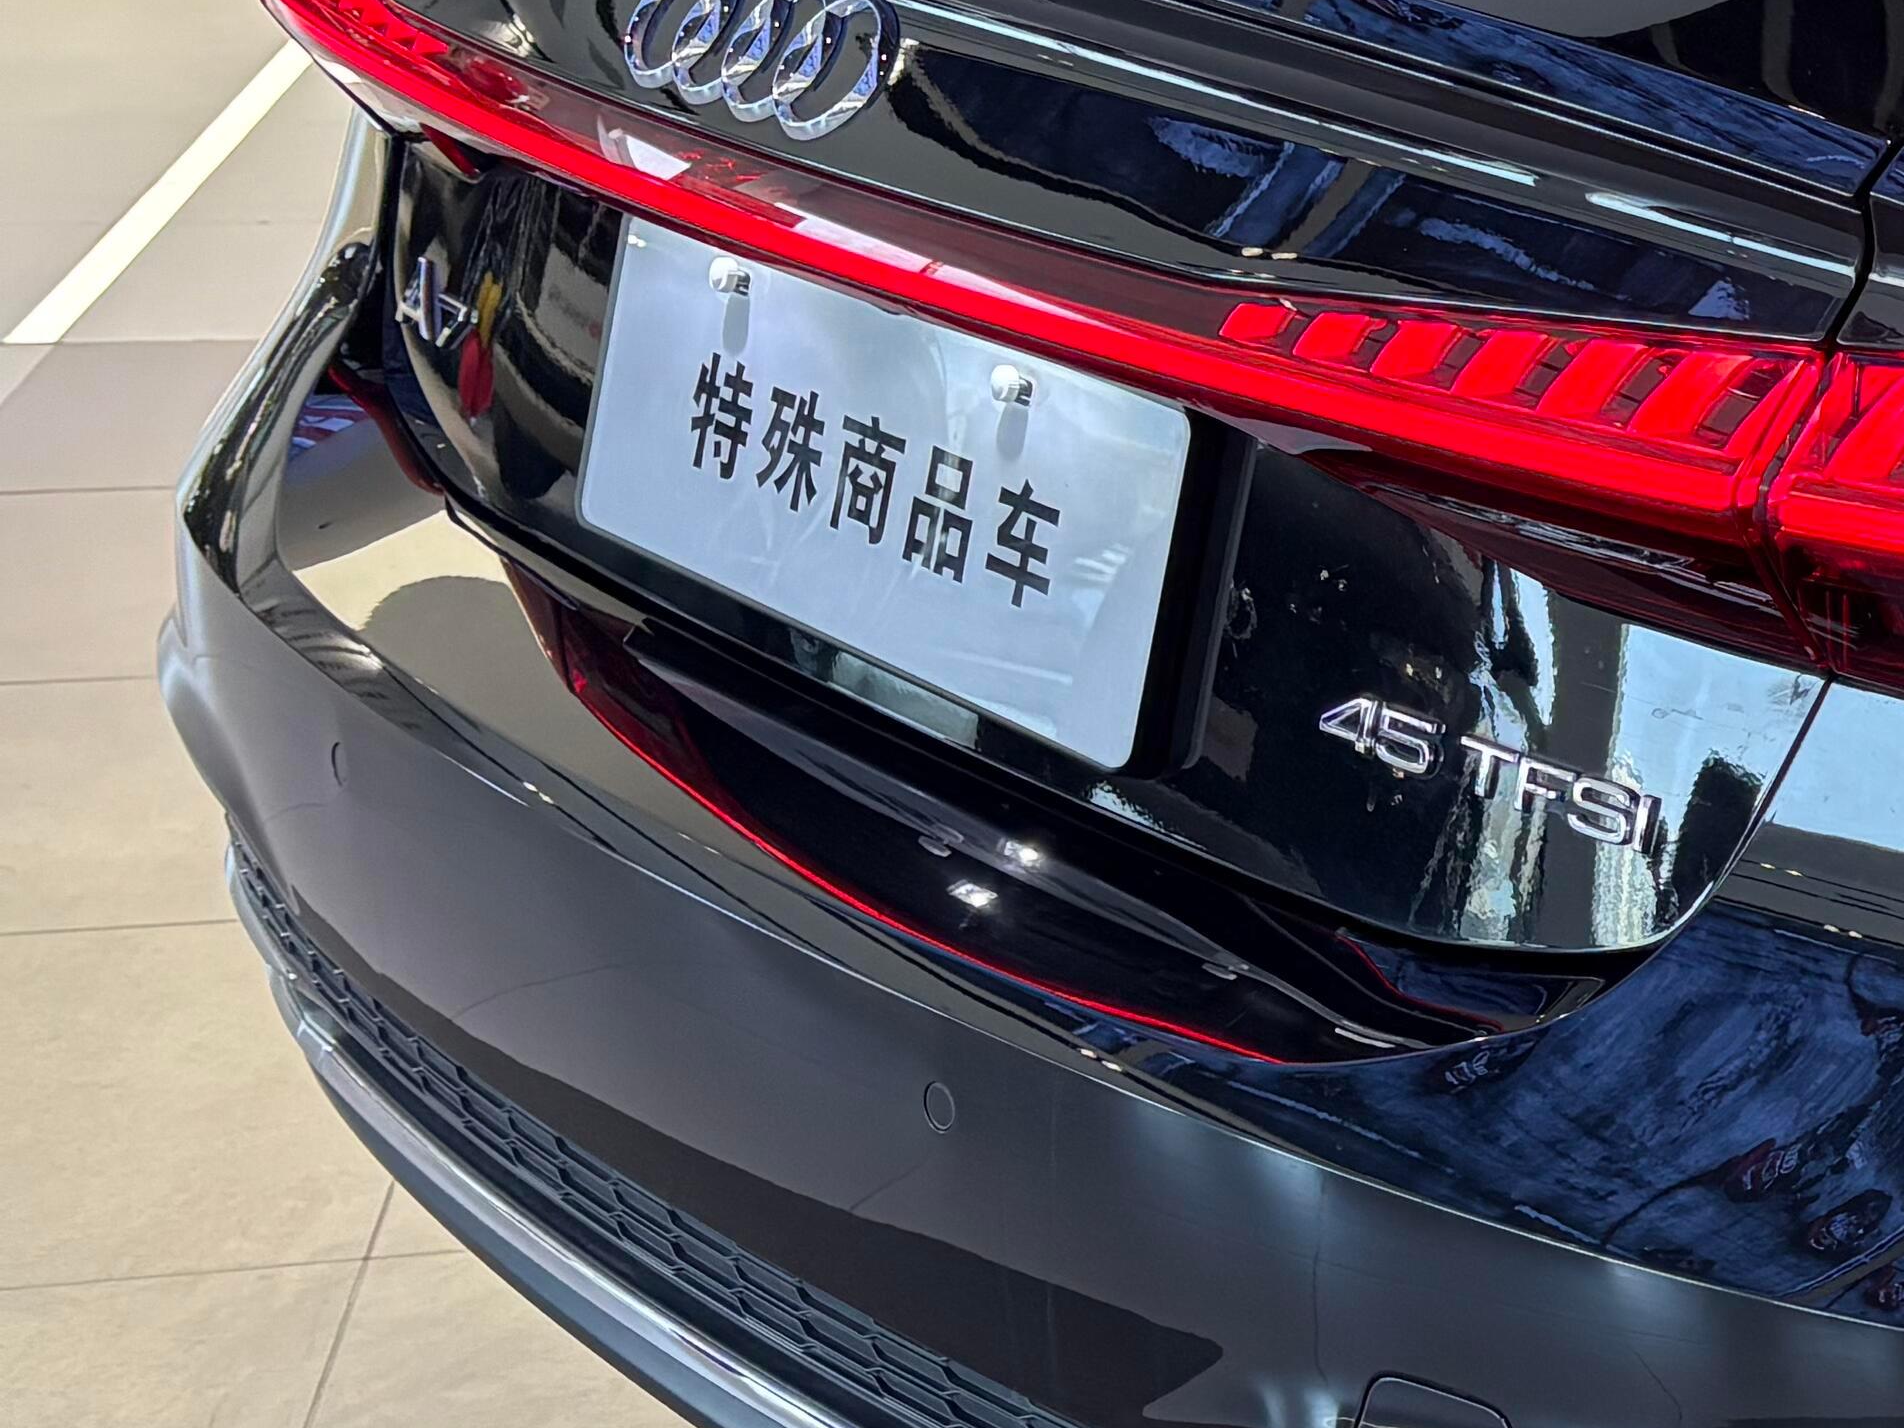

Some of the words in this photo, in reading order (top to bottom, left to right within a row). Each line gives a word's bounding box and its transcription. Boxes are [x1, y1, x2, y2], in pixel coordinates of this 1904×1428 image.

[690, 351, 1060, 609] 特殊商品车
[1319, 693, 1446, 776] 45
[1460, 734, 1664, 855] TFSI
